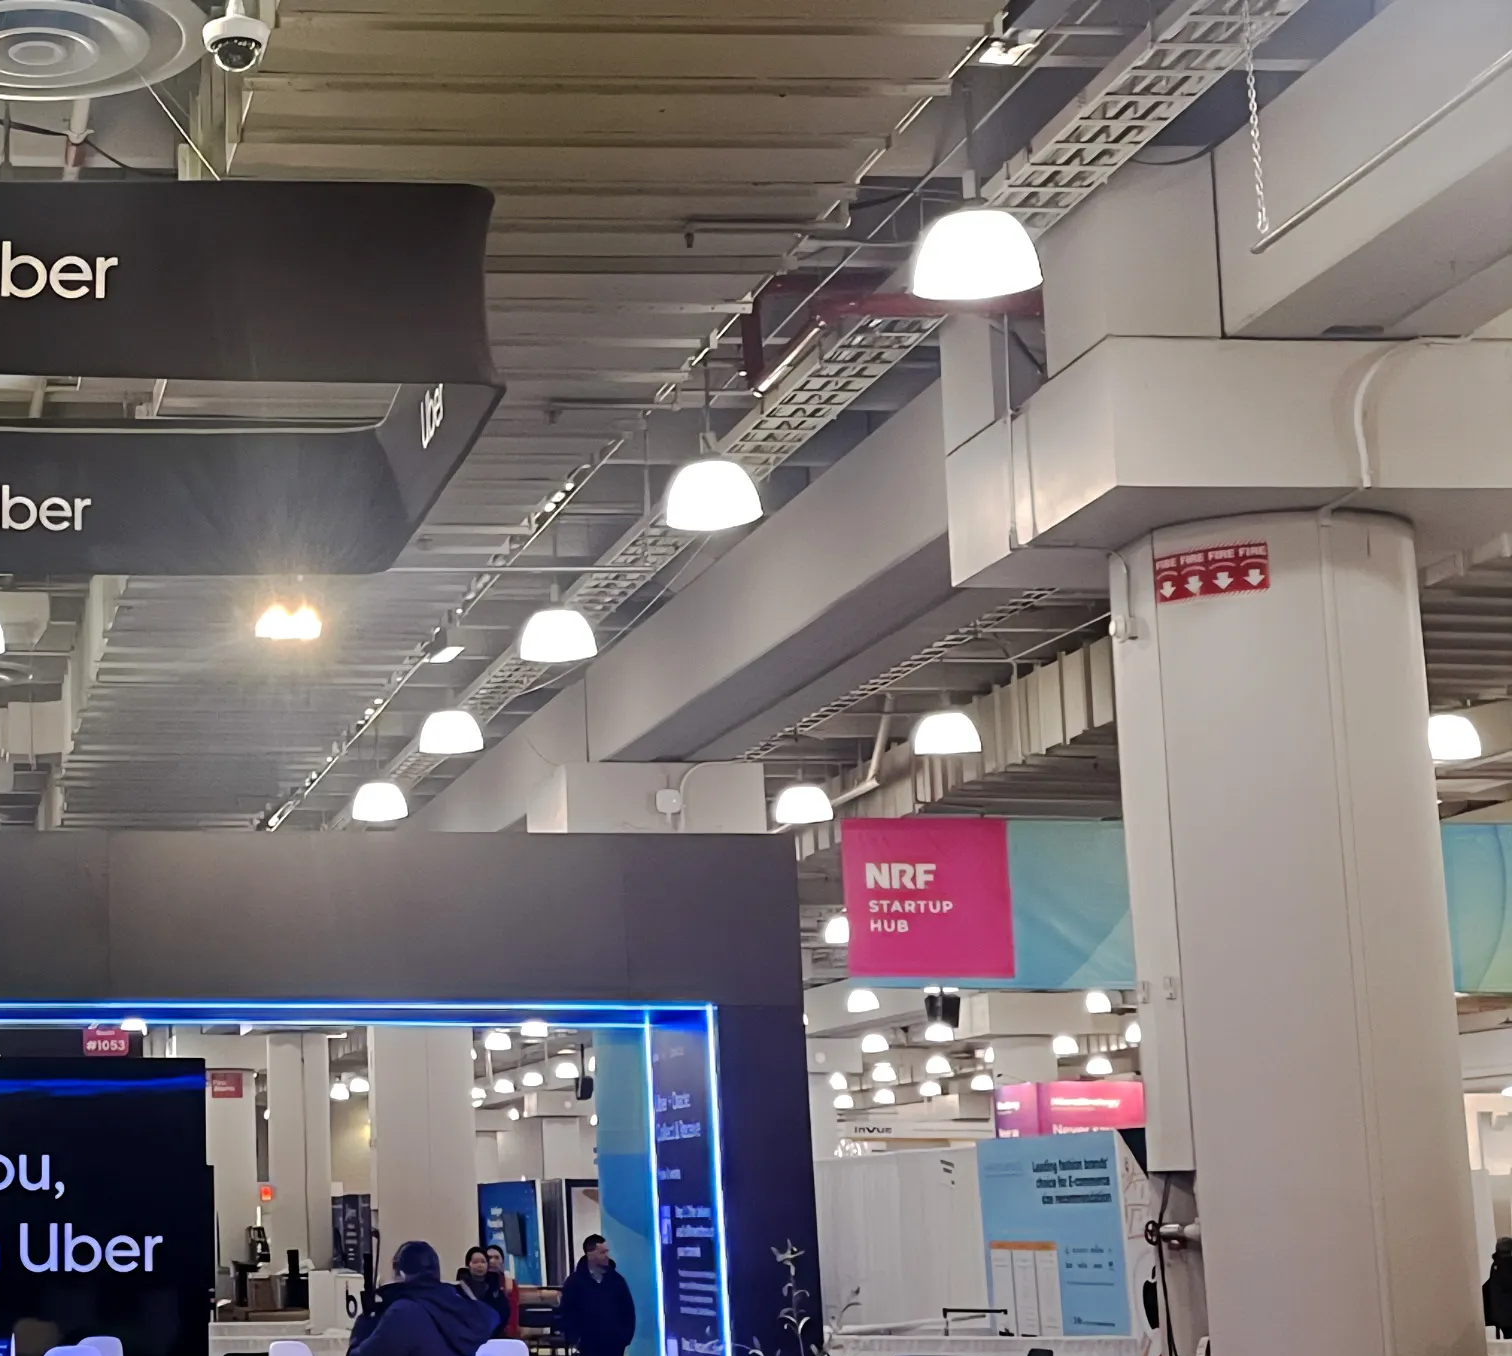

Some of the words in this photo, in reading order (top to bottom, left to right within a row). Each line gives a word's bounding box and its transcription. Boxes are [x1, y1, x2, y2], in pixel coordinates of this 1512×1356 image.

[1155, 557, 1177, 571] FIRE
[1179, 552, 1205, 565] FIRE
[1208, 548, 1235, 561] FIRE
[1238, 545, 1267, 557] FIRE
[865, 862, 937, 890] NRF
[868, 899, 954, 914] STARTUP
[870, 918, 909, 933] HUB
[85, 1039, 126, 1051] #1053
[19, 1222, 164, 1273] Uber
